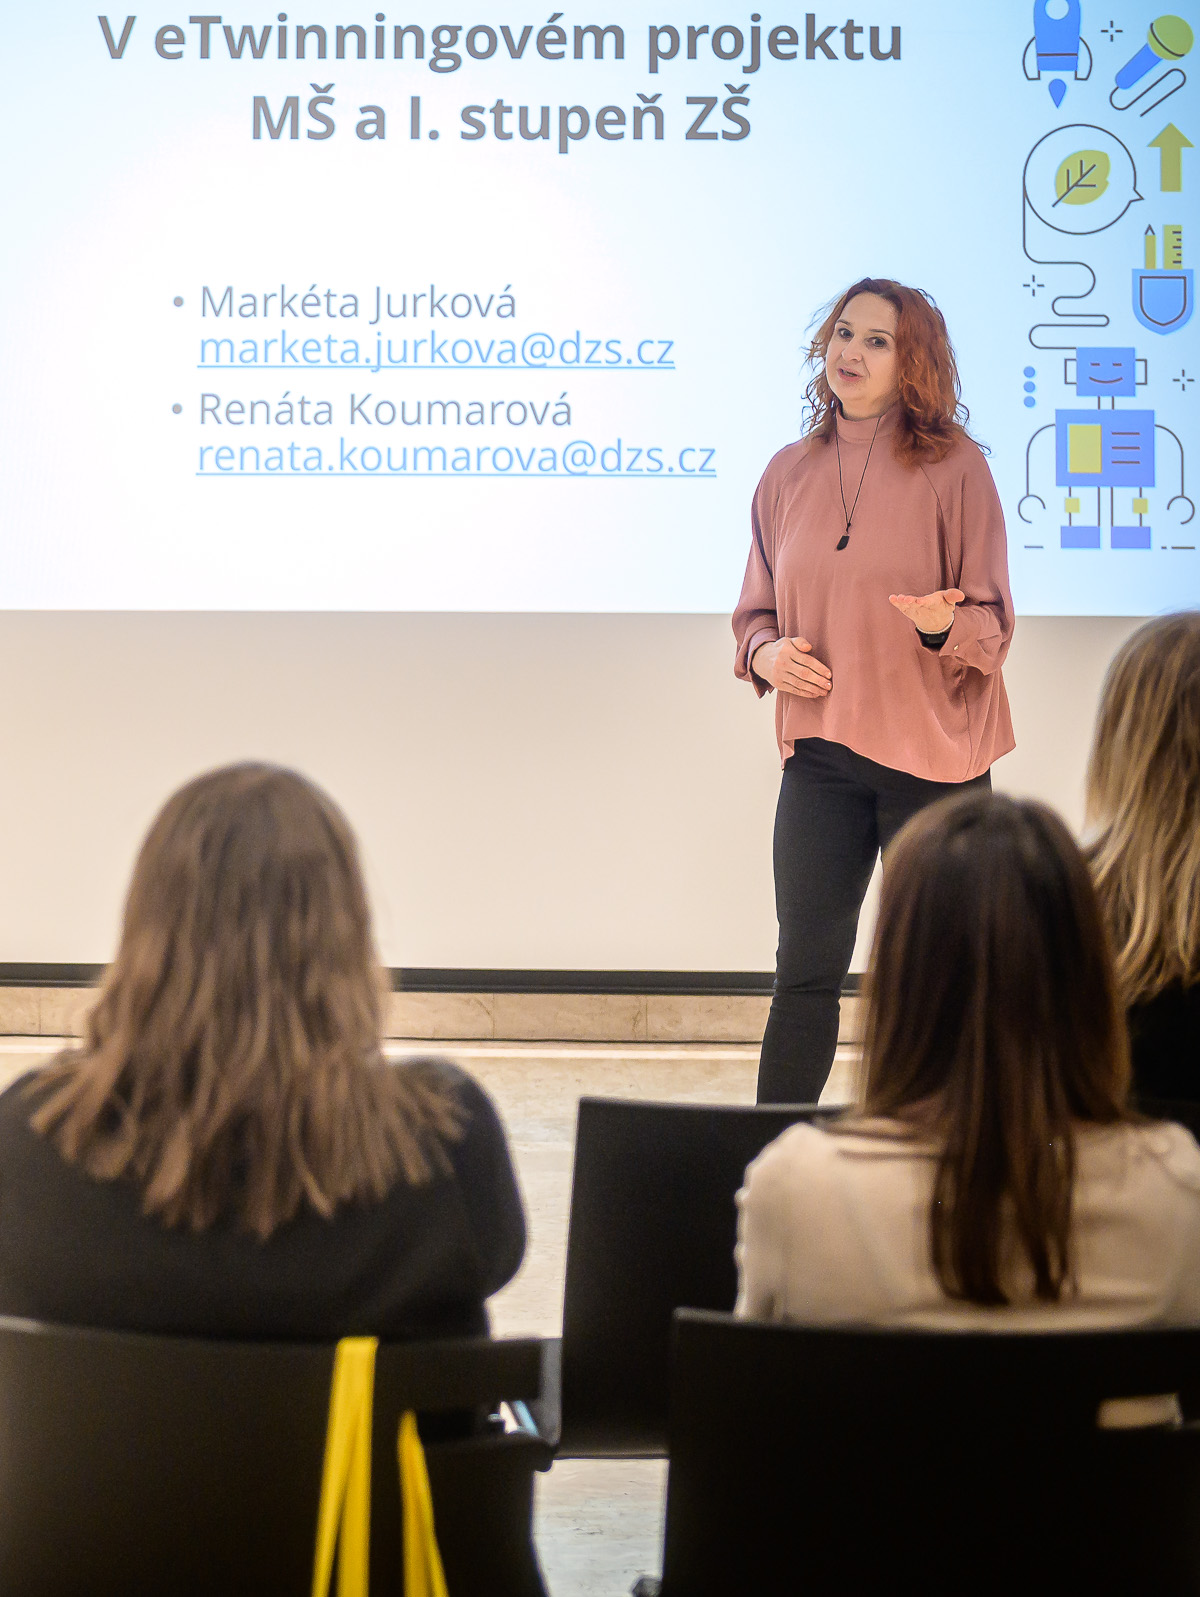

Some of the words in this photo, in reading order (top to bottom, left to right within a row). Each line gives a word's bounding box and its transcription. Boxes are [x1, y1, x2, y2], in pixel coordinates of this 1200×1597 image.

[97, 15, 137, 60] V
[154, 12, 626, 74] eTwinningovém
[648, 12, 902, 75] projektu
[252, 82, 336, 141] MŠ
[355, 104, 386, 141] a
[460, 92, 665, 155] stupeň
[685, 83, 752, 142] ZŠ
[201, 283, 360, 318] Markéta
[368, 283, 517, 325] Jurková
[198, 329, 676, 373] marketa.jurkova@dzs.cz
[200, 390, 334, 426] Renáta
[349, 390, 573, 427] Koumarová
[196, 436, 718, 478] renata.koumarova@dzs.cz
